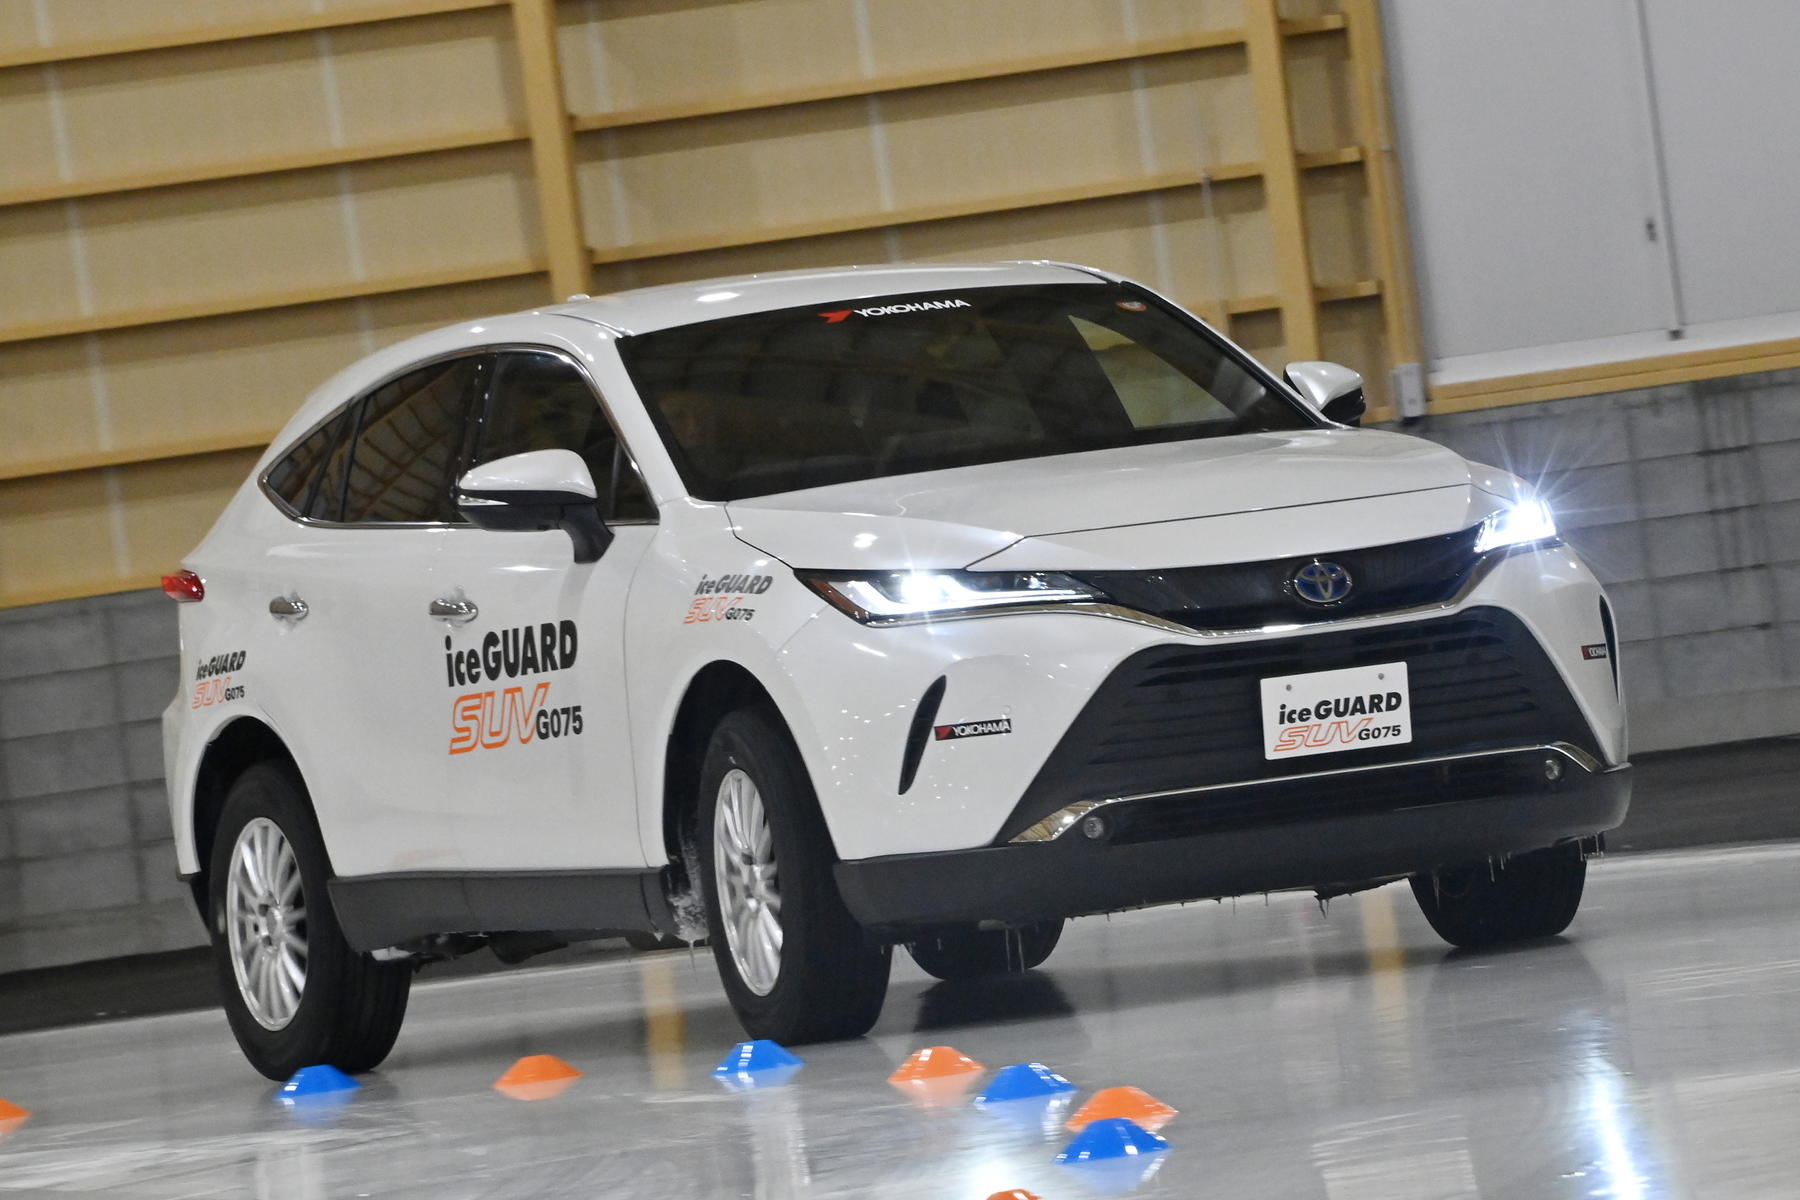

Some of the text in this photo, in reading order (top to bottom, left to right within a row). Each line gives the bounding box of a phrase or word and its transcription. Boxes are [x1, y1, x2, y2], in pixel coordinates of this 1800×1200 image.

[853, 299, 972, 318] YOKOHAMA
[445, 619, 578, 687] iceGUARD
[448, 681, 583, 755] SUV G075
[1279, 691, 1402, 725] iceGUARD
[951, 720, 1011, 737] YOKOHAMA
[1273, 717, 1401, 752] SUV G075
